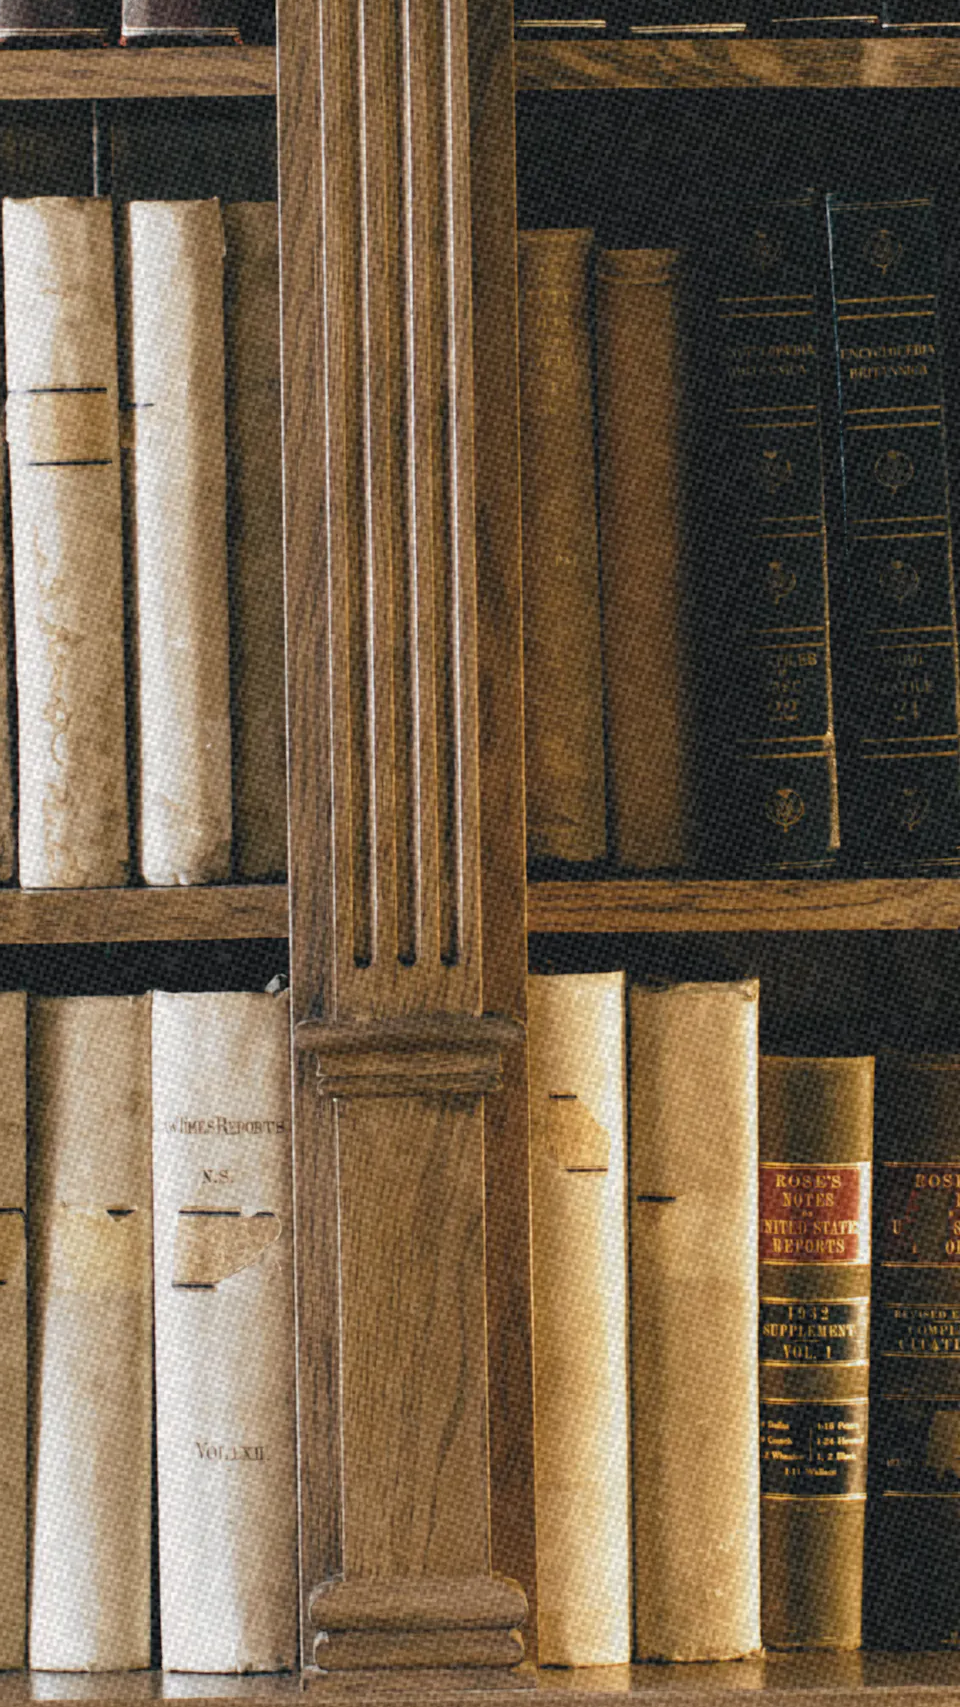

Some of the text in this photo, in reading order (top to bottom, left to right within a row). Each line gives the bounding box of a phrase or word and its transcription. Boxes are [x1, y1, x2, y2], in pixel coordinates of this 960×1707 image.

[775, 1173, 842, 1189] ROSE'S
[782, 1192, 835, 1208] NOTES
[762, 1219, 807, 1236] NITED
[771, 1237, 845, 1254] REPORTS
[762, 1323, 857, 1338] SUPPLEMENT
[782, 1343, 817, 1360] VOL.
